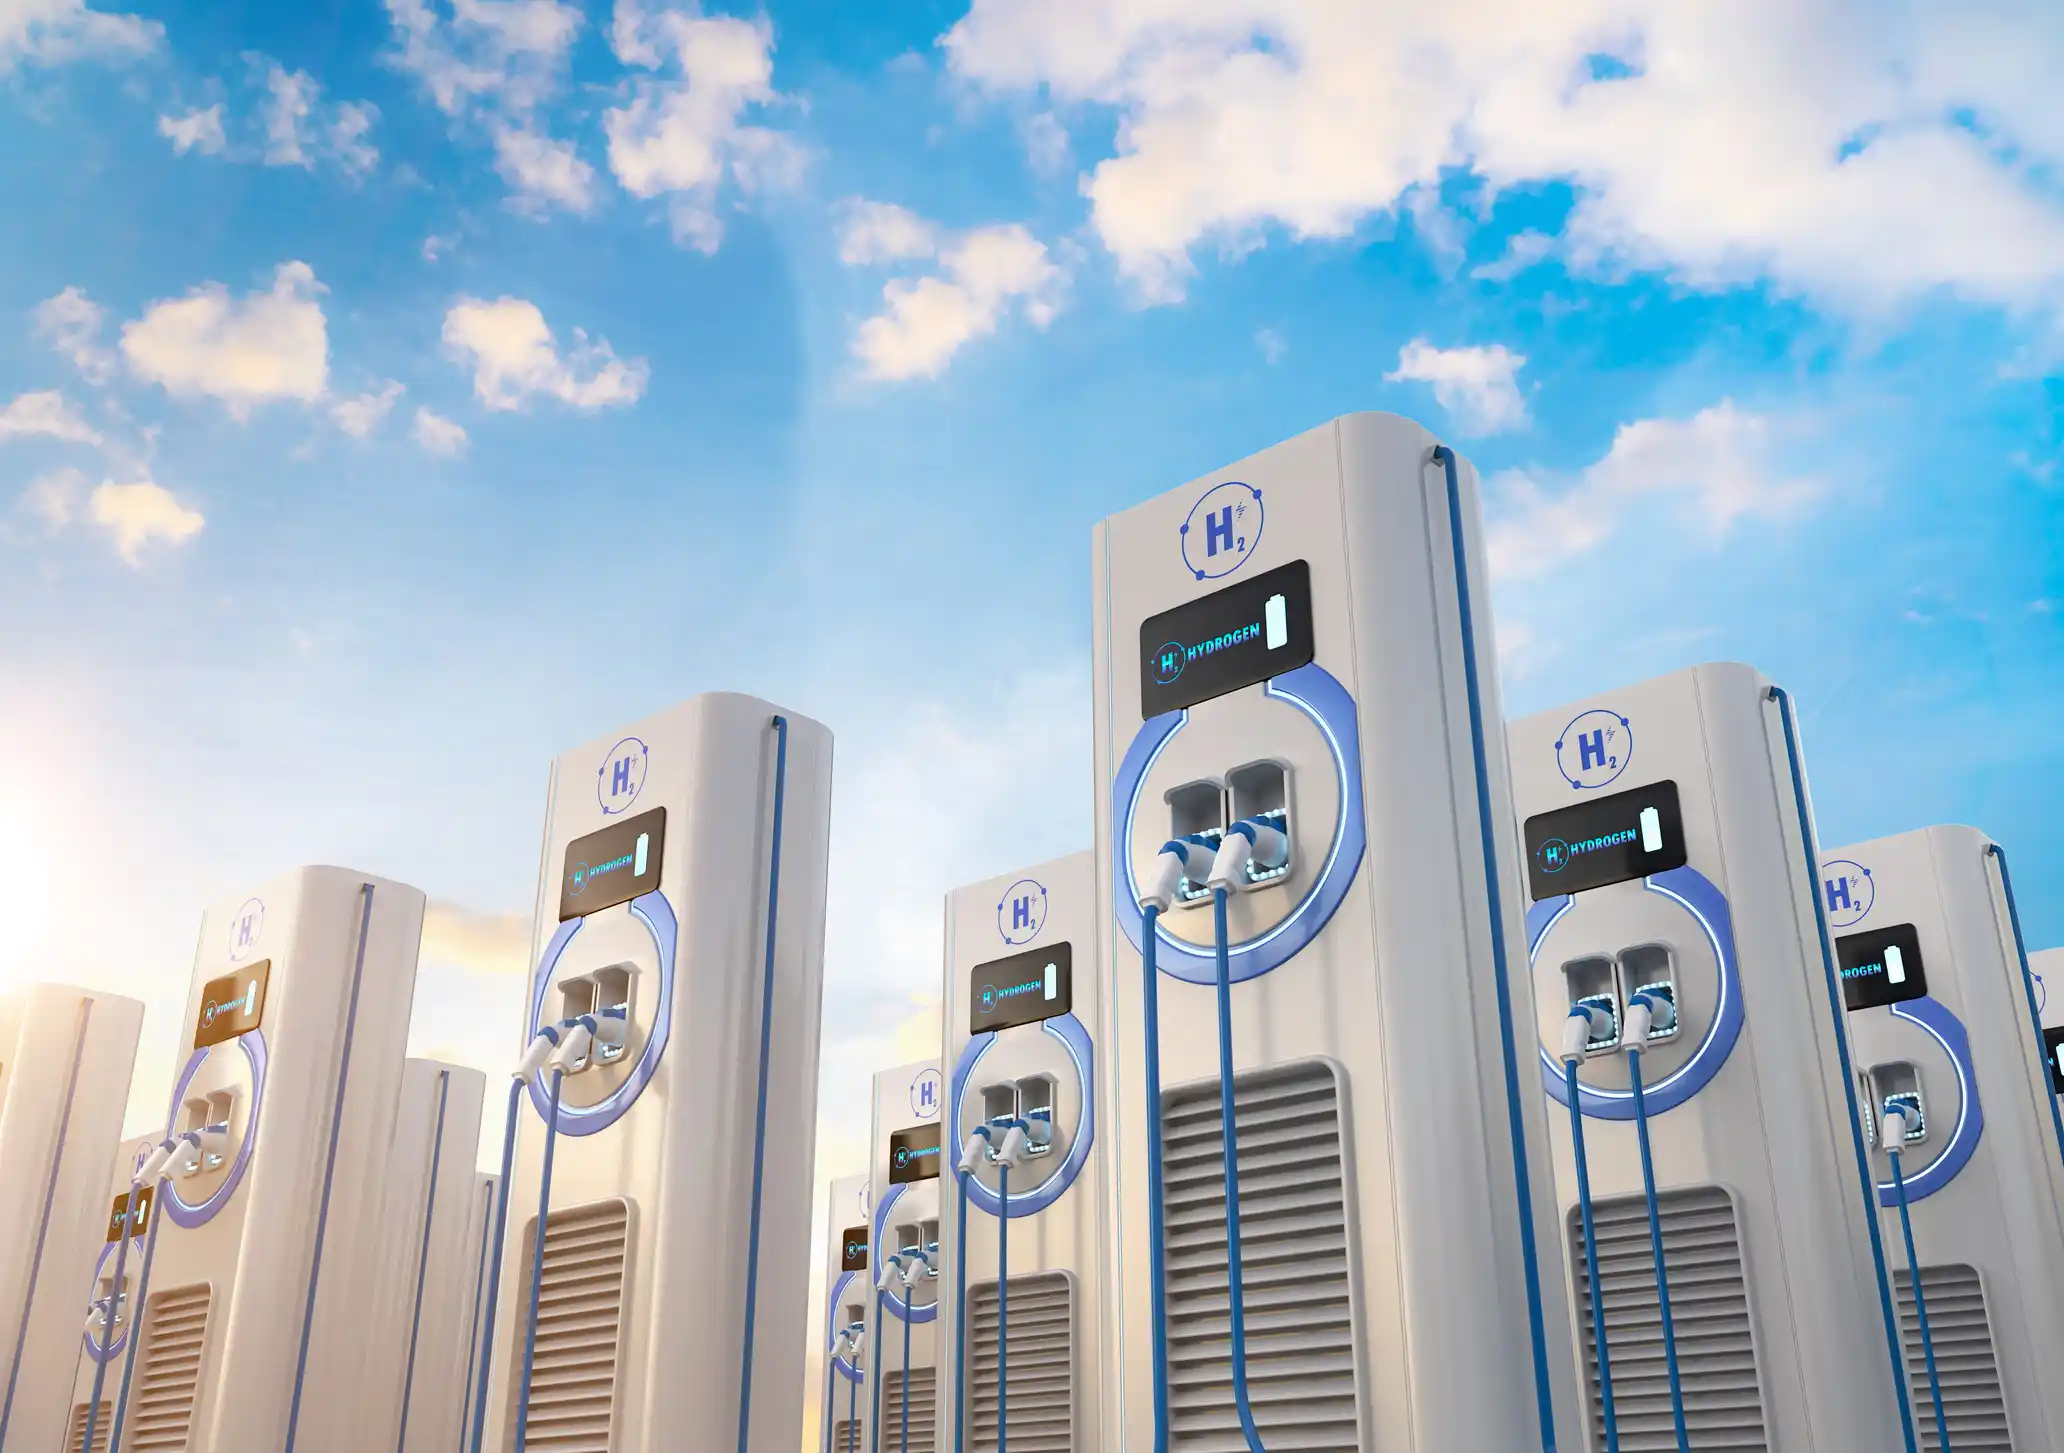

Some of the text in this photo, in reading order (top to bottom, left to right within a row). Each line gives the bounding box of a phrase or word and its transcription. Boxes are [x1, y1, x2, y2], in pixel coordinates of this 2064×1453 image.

[1187, 623, 1260, 661] HYDROGEN
[1570, 828, 1636, 856] HYDROGEN
[589, 854, 632, 878] HYDROGEN
[1840, 963, 1882, 980] DROGEN
[998, 980, 1041, 999] HYDROGEN
